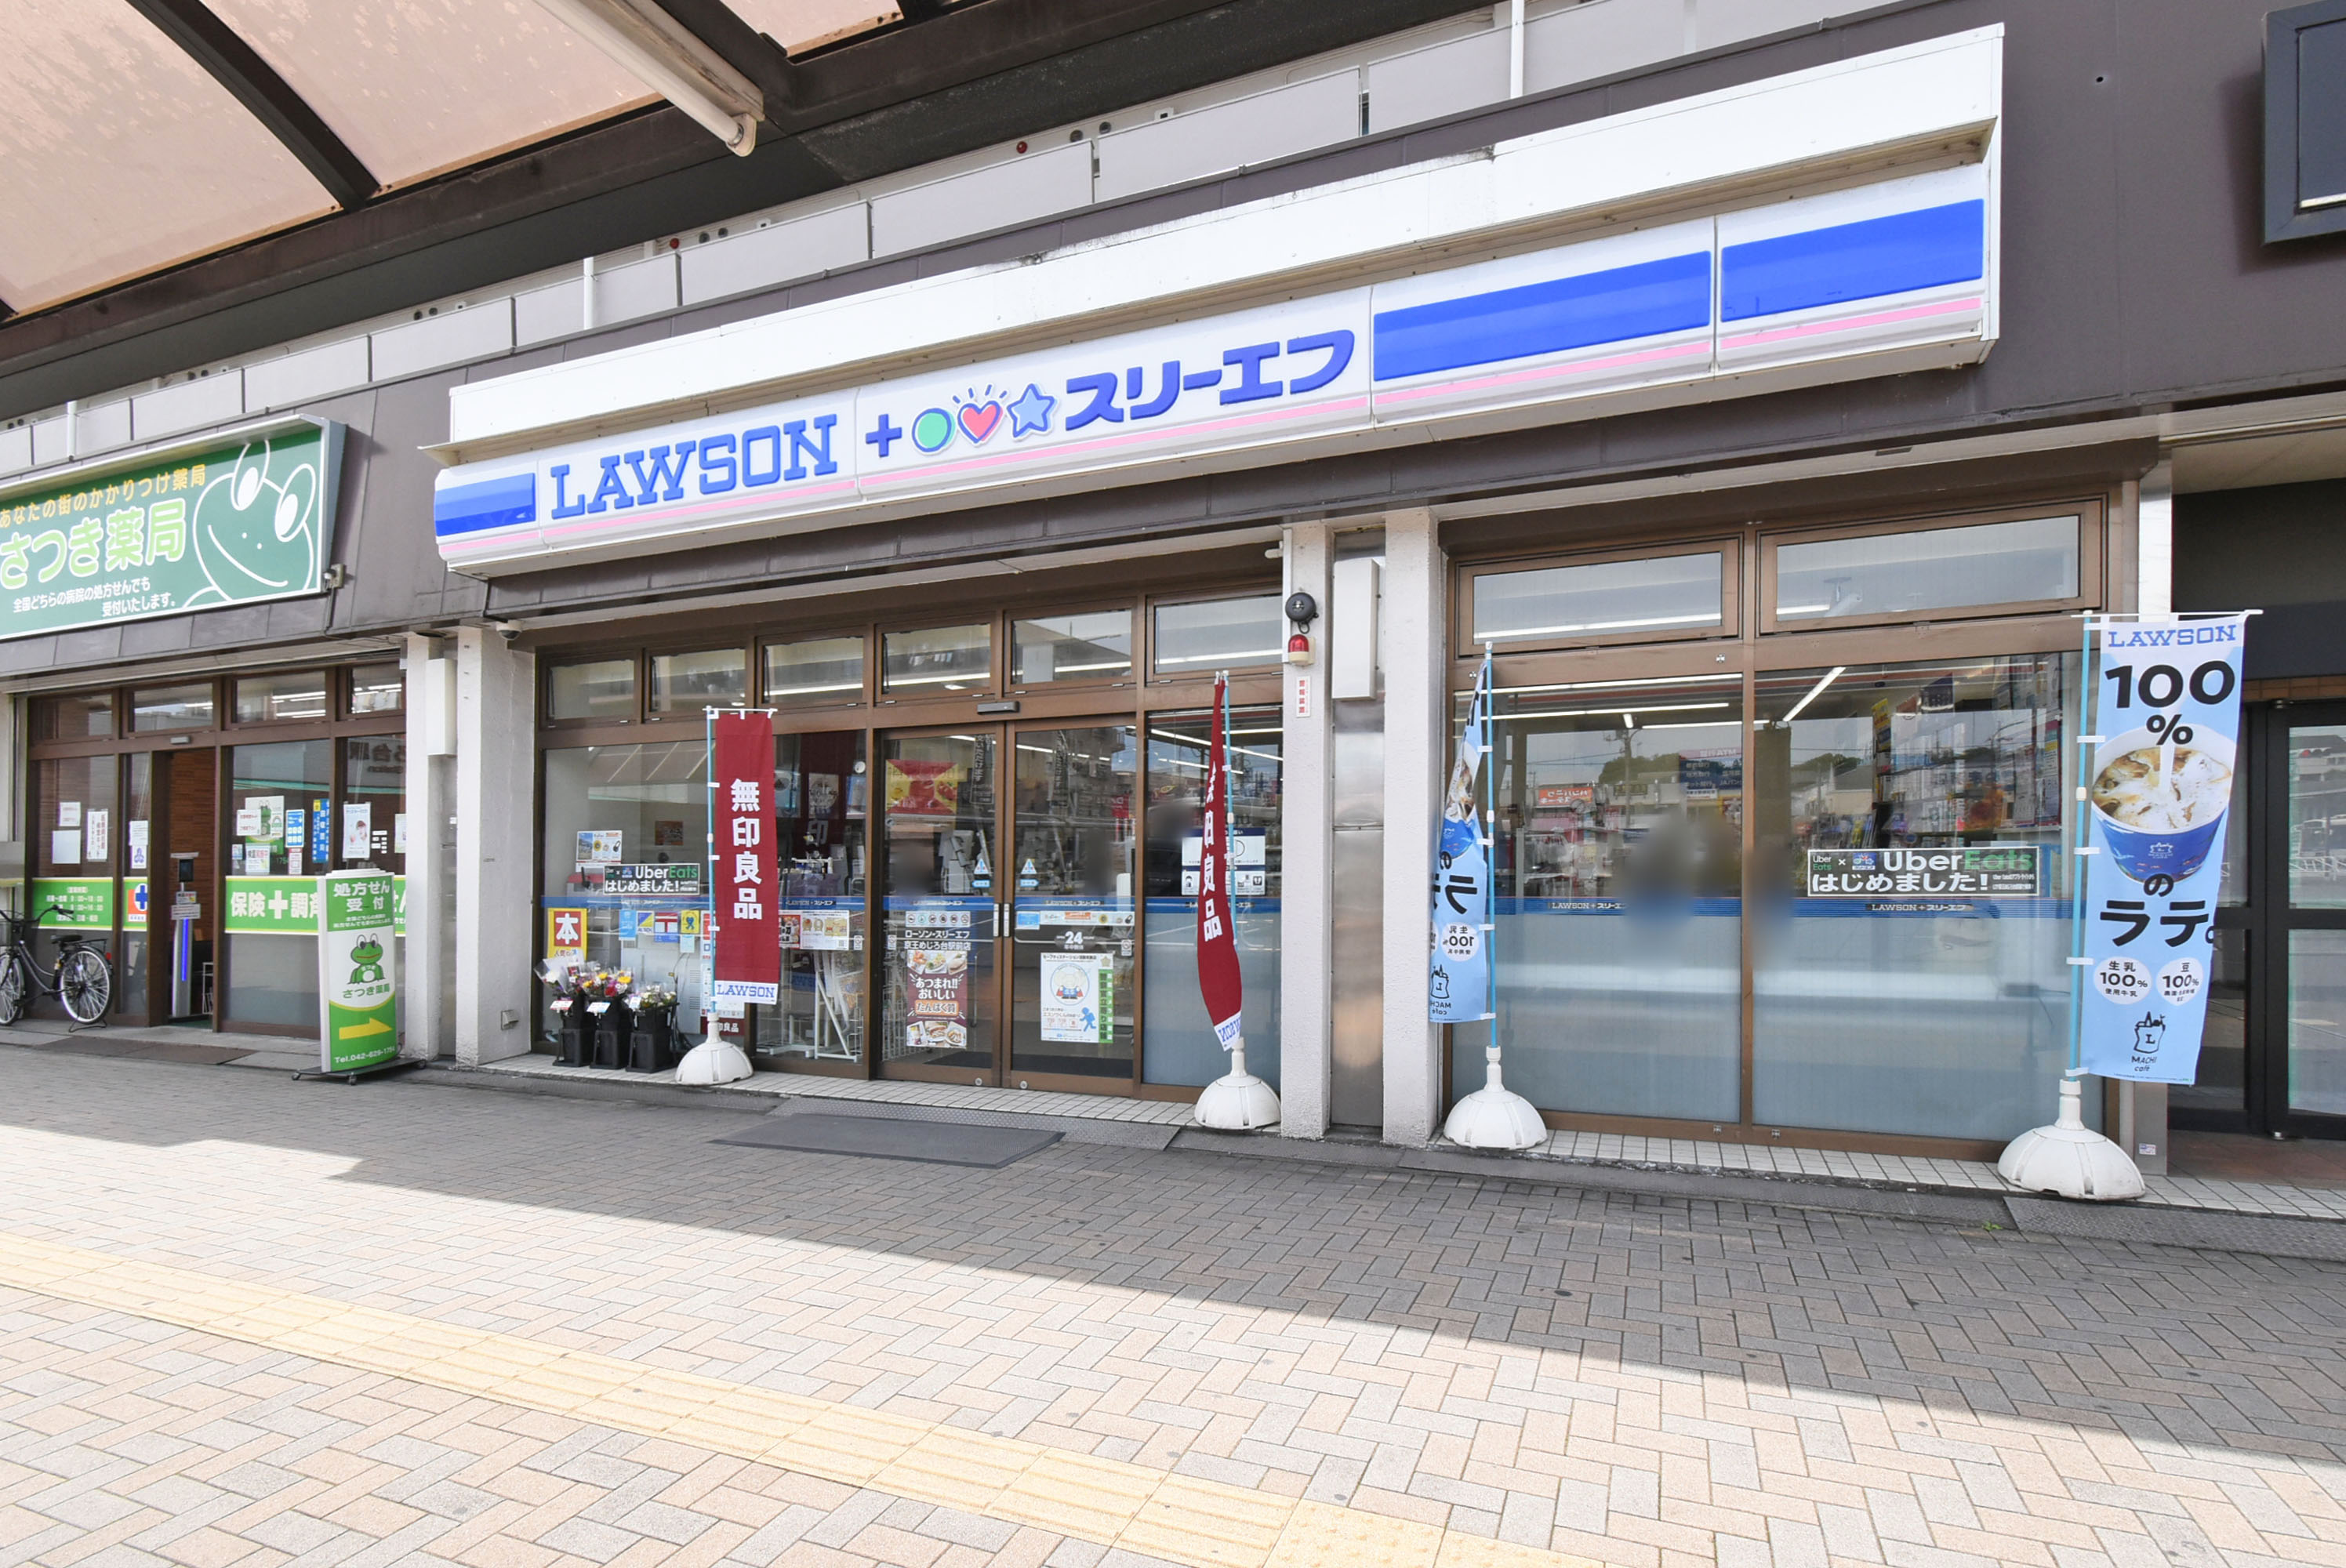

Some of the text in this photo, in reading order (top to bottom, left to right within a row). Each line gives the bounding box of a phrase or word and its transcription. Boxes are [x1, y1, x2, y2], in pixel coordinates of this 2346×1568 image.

[550, 413, 837, 520] LAWSON
[1066, 328, 1355, 431] スリーエフ
[0, 464, 205, 528] あなたの街のかかりつけ薬局
[1, 497, 187, 590] さつき薬局
[13, 576, 151, 613] 全国どちらの病院の処方せんでも
[102, 591, 176, 618] 受付いたします。
[2108, 624, 2237, 648] LAWSON
[2104, 660, 2235, 709] 100
[730, 779, 762, 920] 無印良品
[333, 880, 390, 897] 処方せん
[1812, 873, 1988, 892] はじめました!
[2144, 873, 2174, 897] の
[231, 891, 266, 918] 保険
[556, 913, 579, 945] 本
[905, 930, 971, 938] ローソン・スリーエフ
[1065, 931, 1084, 944] 24
[2108, 960, 2136, 972] 生乳
[2181, 962, 2190, 972] 豆
[2100, 971, 2148, 988] 100%
[2162, 975, 2199, 988] 100%
[717, 984, 775, 998] LAWSON
[918, 989, 955, 1000] おいしい
[2105, 988, 2138, 997] 使用牛乳
